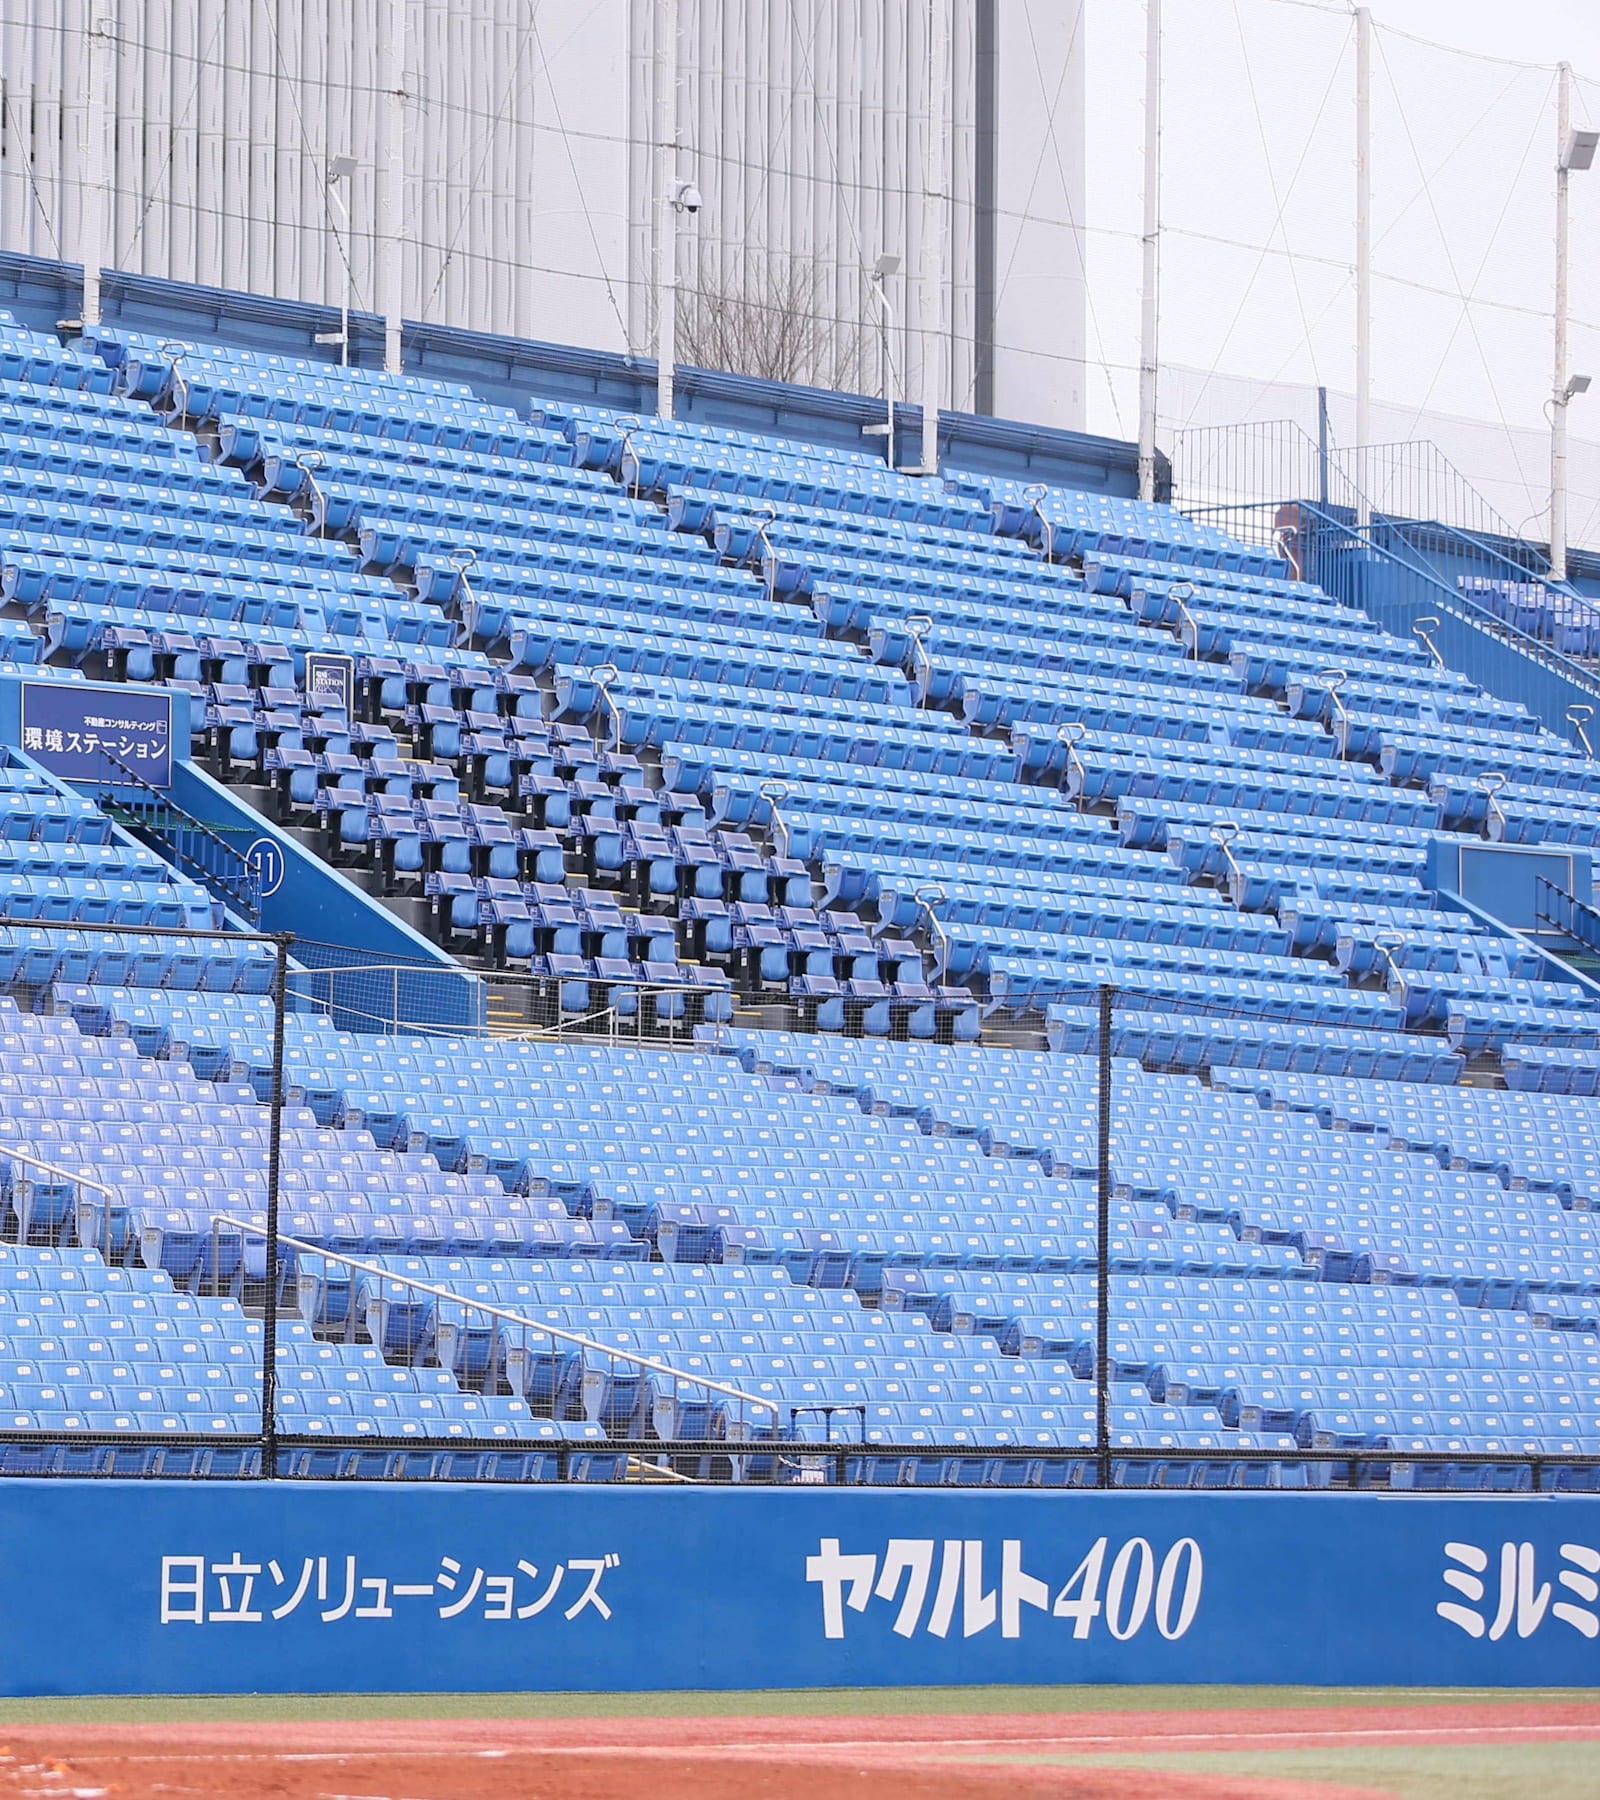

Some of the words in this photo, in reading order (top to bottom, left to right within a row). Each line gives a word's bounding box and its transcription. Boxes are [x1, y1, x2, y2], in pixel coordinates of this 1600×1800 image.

[24, 727, 167, 760] 環境ステーション
[254, 852, 274, 882] 11
[161, 1551, 621, 1625] 日立ソリューションズ
[805, 1537, 1203, 1640] ヤクルト400
[1436, 1541, 1600, 1641] ミルミ
